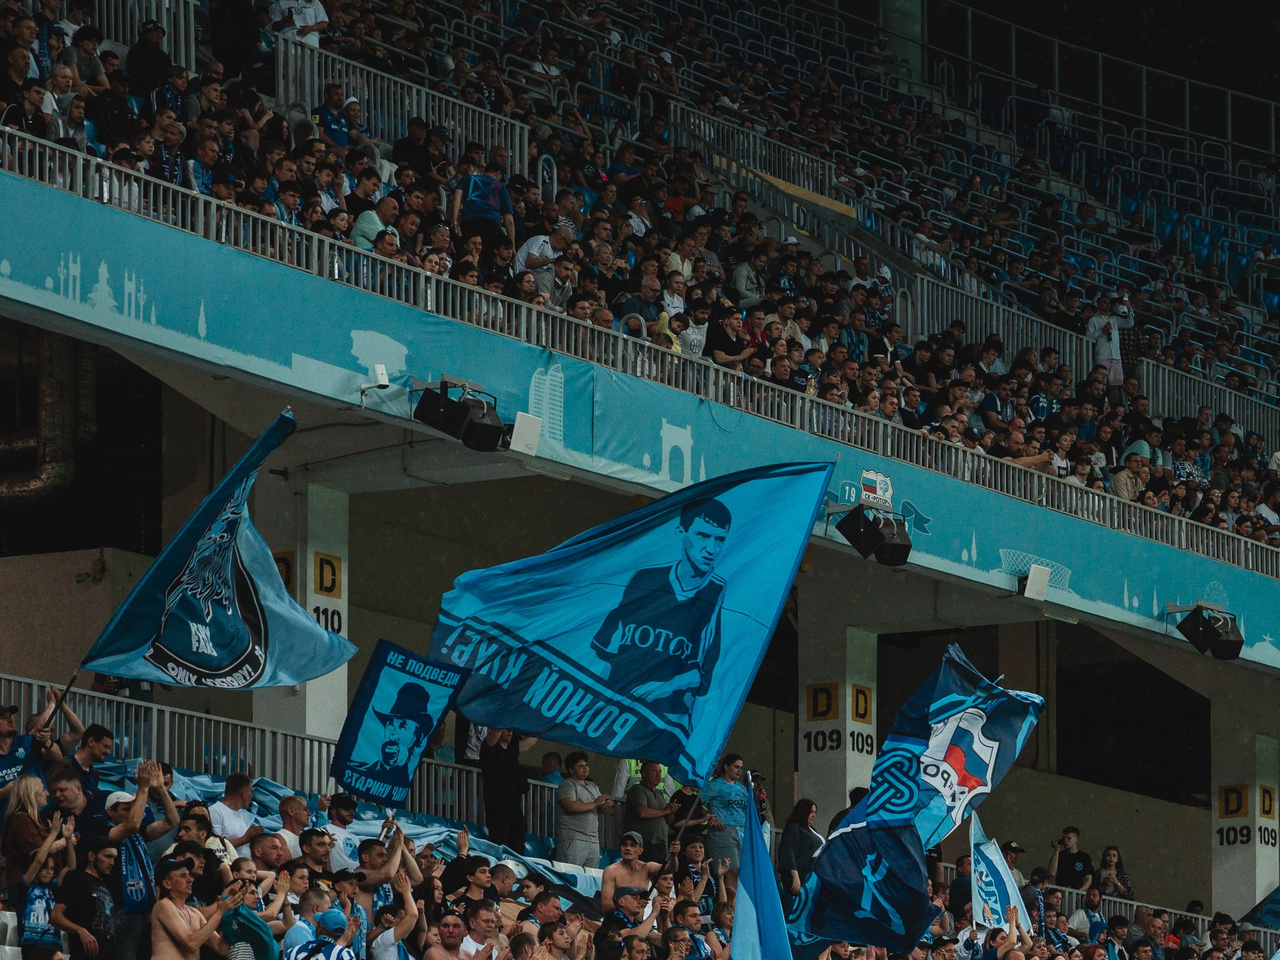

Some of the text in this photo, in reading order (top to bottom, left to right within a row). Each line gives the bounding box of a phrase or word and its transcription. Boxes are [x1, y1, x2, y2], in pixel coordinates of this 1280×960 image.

[319, 557, 336, 593] D
[313, 605, 342, 635] 110
[386, 650, 461, 686] НЕ ПОДВЕДИ
[812, 687, 833, 718] D
[855, 688, 868, 719] D
[803, 729, 842, 752] 109
[849, 730, 874, 755] 109
[343, 769, 392, 799] СТАРИНУ
[1224, 788, 1243, 816] D
[1262, 788, 1272, 816] D
[1216, 825, 1252, 846] 109
[1258, 825, 1277, 848] 109
